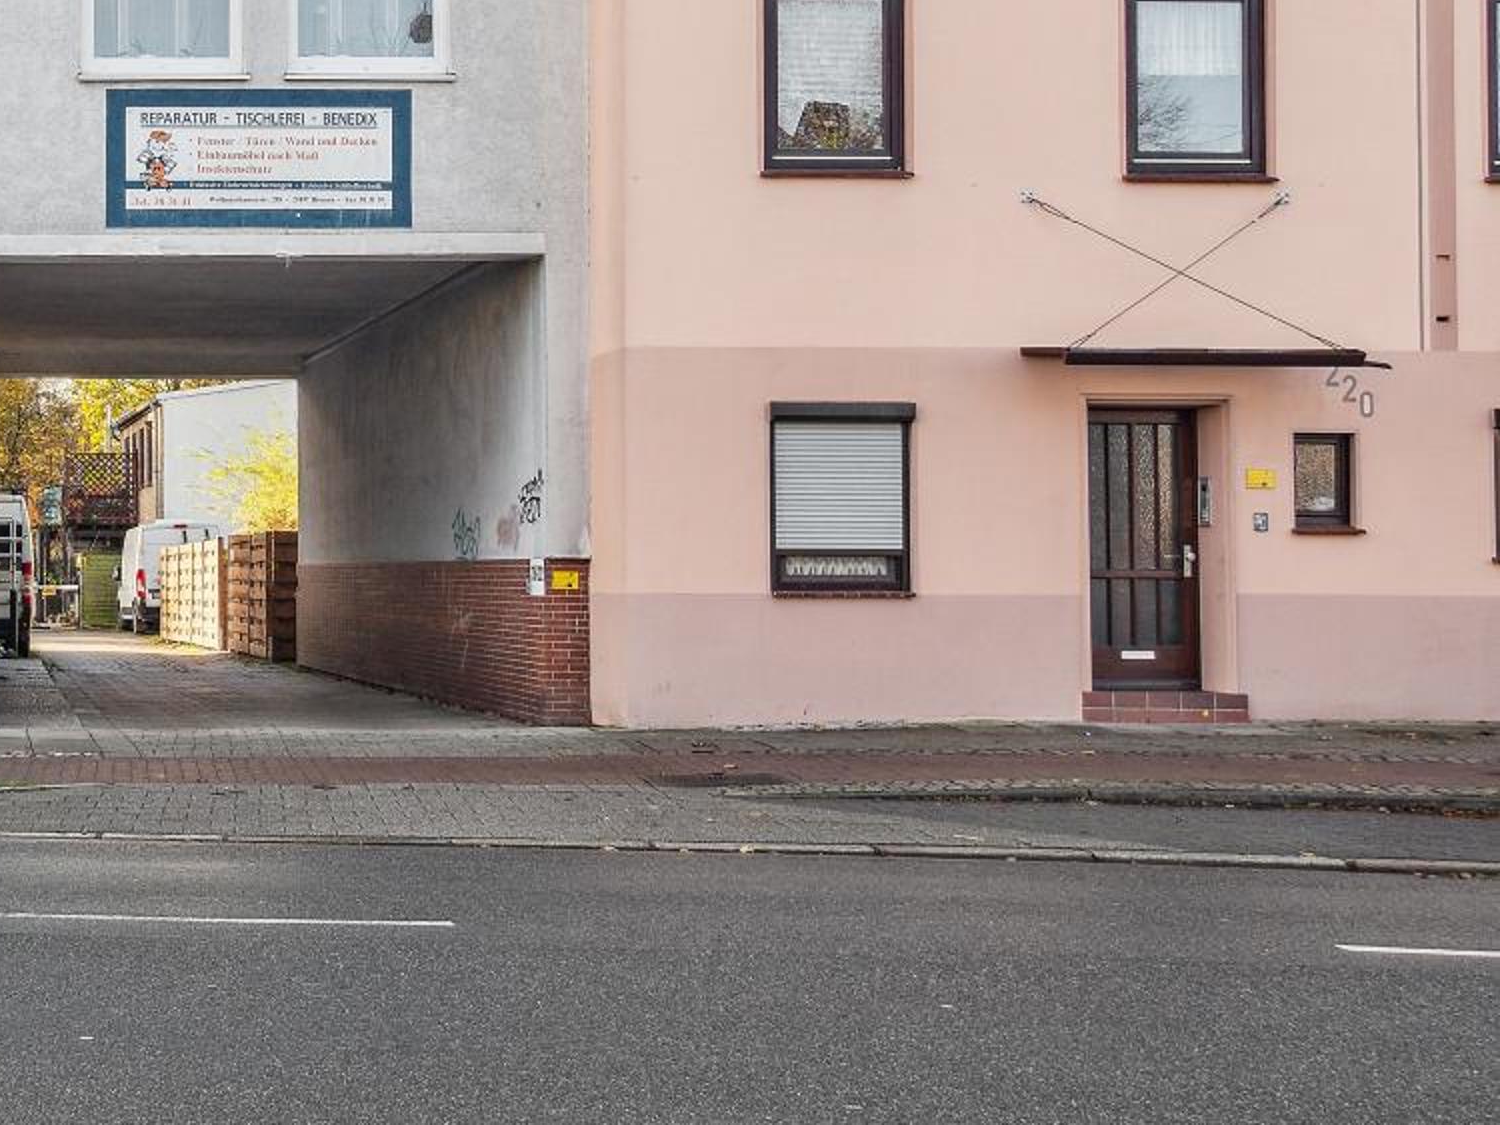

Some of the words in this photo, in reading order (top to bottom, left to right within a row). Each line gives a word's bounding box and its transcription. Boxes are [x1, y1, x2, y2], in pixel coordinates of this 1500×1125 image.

[140, 112, 217, 125] REPARATUR
[236, 112, 305, 125] TISCHLEREI
[323, 112, 377, 125] BENEDIX
[1325, 366, 1375, 418] 220
